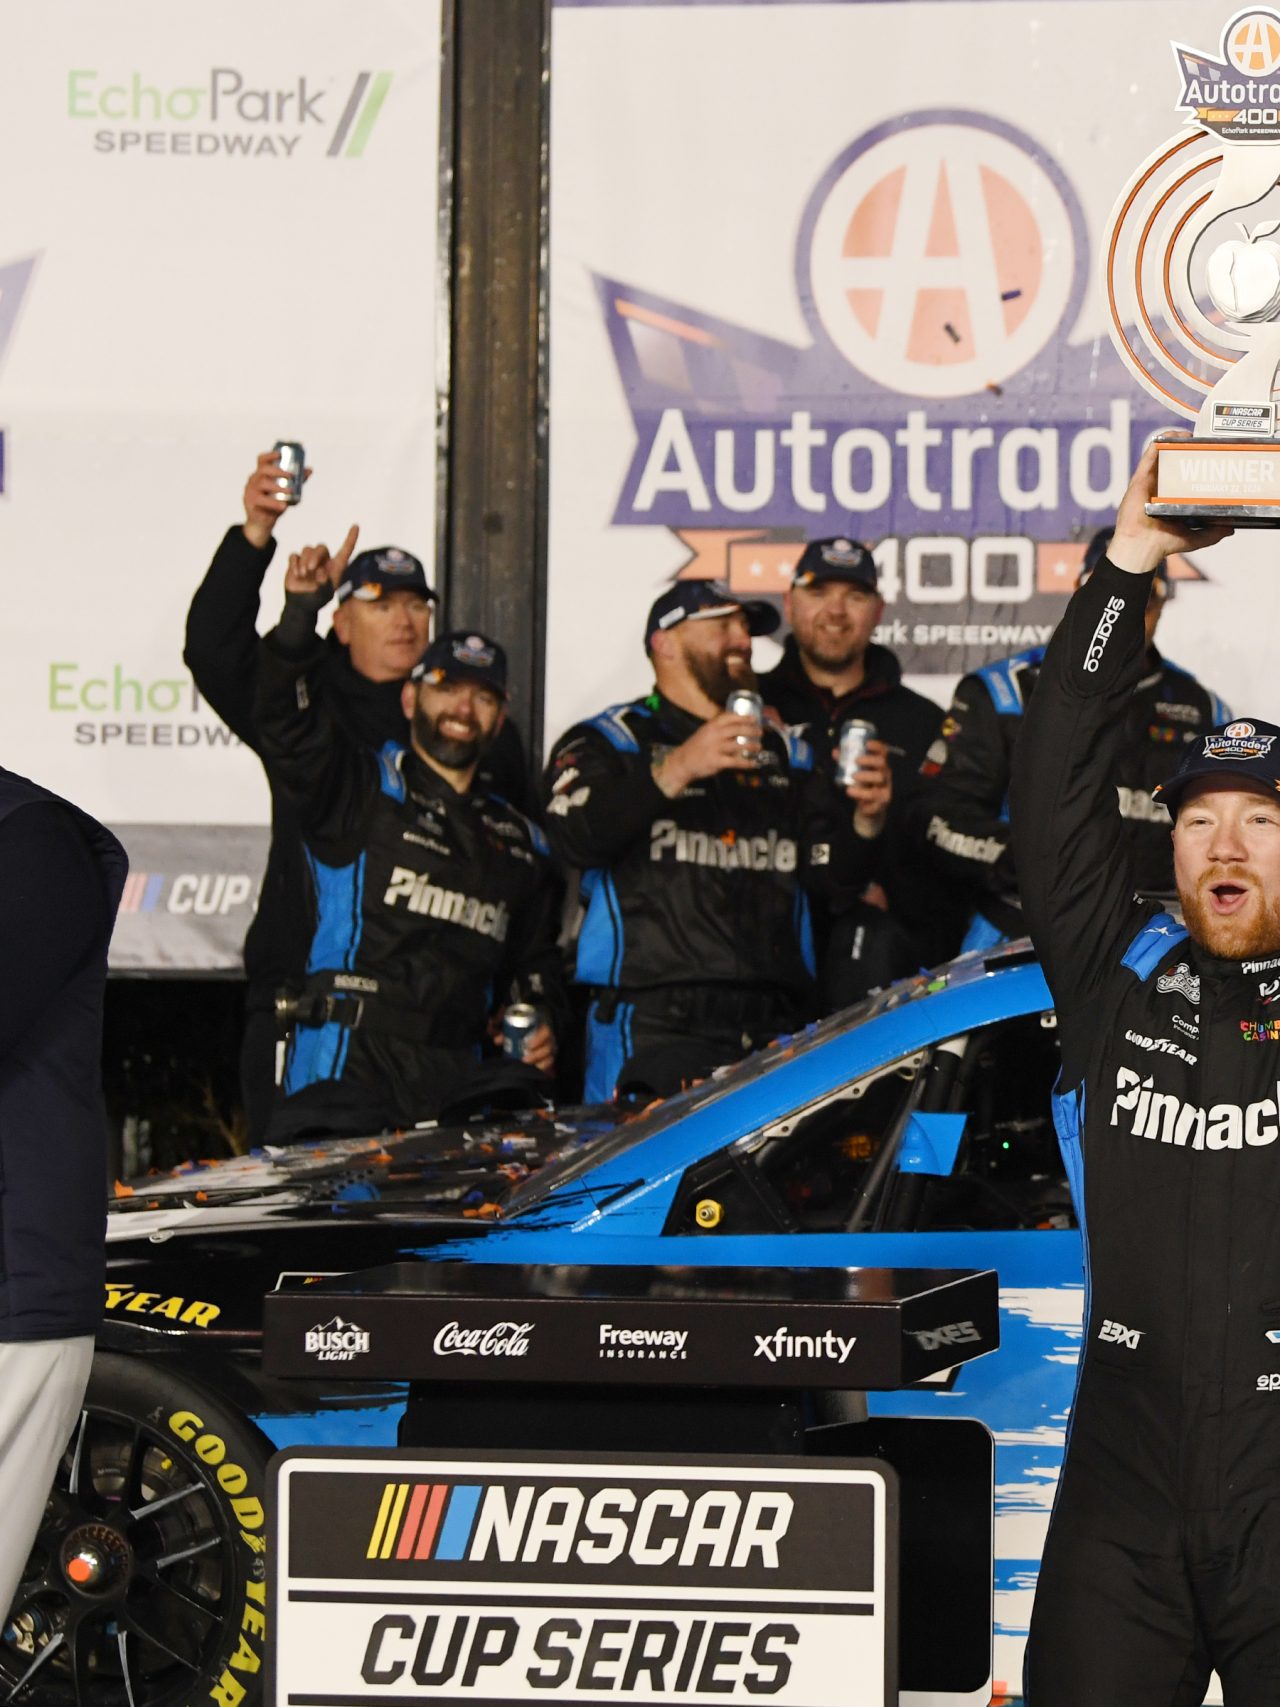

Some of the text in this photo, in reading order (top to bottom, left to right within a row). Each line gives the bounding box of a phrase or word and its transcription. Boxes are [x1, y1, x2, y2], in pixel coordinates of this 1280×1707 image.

[66, 67, 326, 124] EchoPark
[1232, 108, 1278, 125] 400
[93, 129, 302, 158] SPEEDWAY
[1221, 418, 1263, 428] CUP SERIES
[1231, 407, 1264, 416] NASCAR
[631, 398, 1192, 513] Autotrad
[1179, 459, 1276, 483] WINNER
[913, 624, 1054, 646] SPEEDWAY
[1083, 595, 1125, 673] sparco
[48, 662, 201, 714] Echo
[74, 723, 244, 747] SPEEDW
[1210, 739, 1268, 751] Autotrader
[167, 874, 250, 915] CUP
[1172, 1014, 1200, 1034] Comp
[105, 1284, 220, 1328] YEAR
[304, 1330, 370, 1353] BUSCH
[433, 1321, 536, 1357] Coca-Cola
[599, 1325, 689, 1351] Freeway
[754, 1327, 857, 1364] xfinity
[1098, 1319, 1147, 1350] 23XI
[316, 1351, 358, 1361] LIGHT
[599, 1350, 688, 1360] INSURANCE
[469, 1485, 795, 1568] NASCAR
[361, 1614, 801, 1695] CUP SERIES
